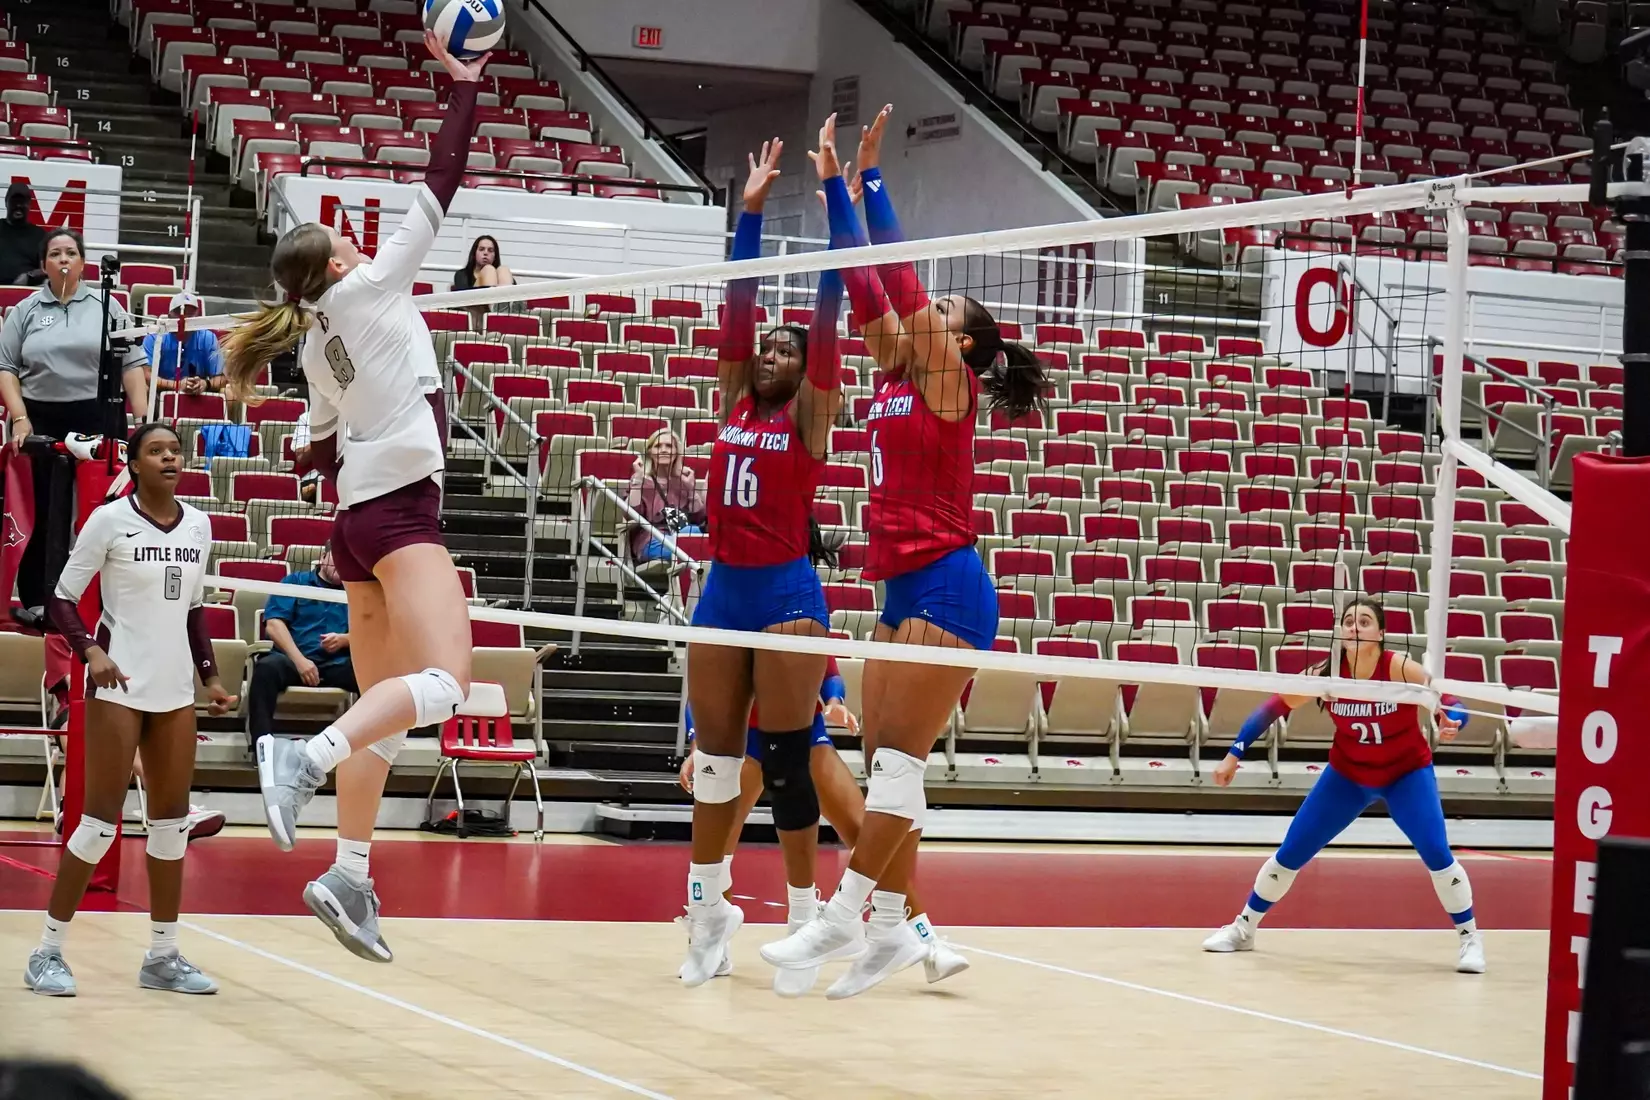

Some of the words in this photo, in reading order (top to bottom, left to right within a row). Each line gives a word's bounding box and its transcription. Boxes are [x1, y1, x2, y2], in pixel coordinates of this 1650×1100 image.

[37, 24, 50, 34] 17
[639, 27, 662, 46] EXIT
[57, 57, 70, 67] 16
[77, 90, 90, 100] 15
[98, 121, 111, 131] 14
[121, 156, 134, 166] 13
[167, 225, 178, 237] 11
[1159, 292, 1169, 304] 11
[325, 335, 356, 391] 8
[884, 395, 914, 417] TECH
[759, 432, 790, 452] TECH
[870, 430, 884, 487] 6
[723, 454, 758, 508] 16
[133, 547, 172, 562] LITTLE
[174, 547, 201, 564] ROCK
[164, 565, 182, 600] 6
[1330, 701, 1373, 717] LOUISIANA
[1374, 701, 1398, 716] TECH
[1350, 722, 1383, 745] 21
